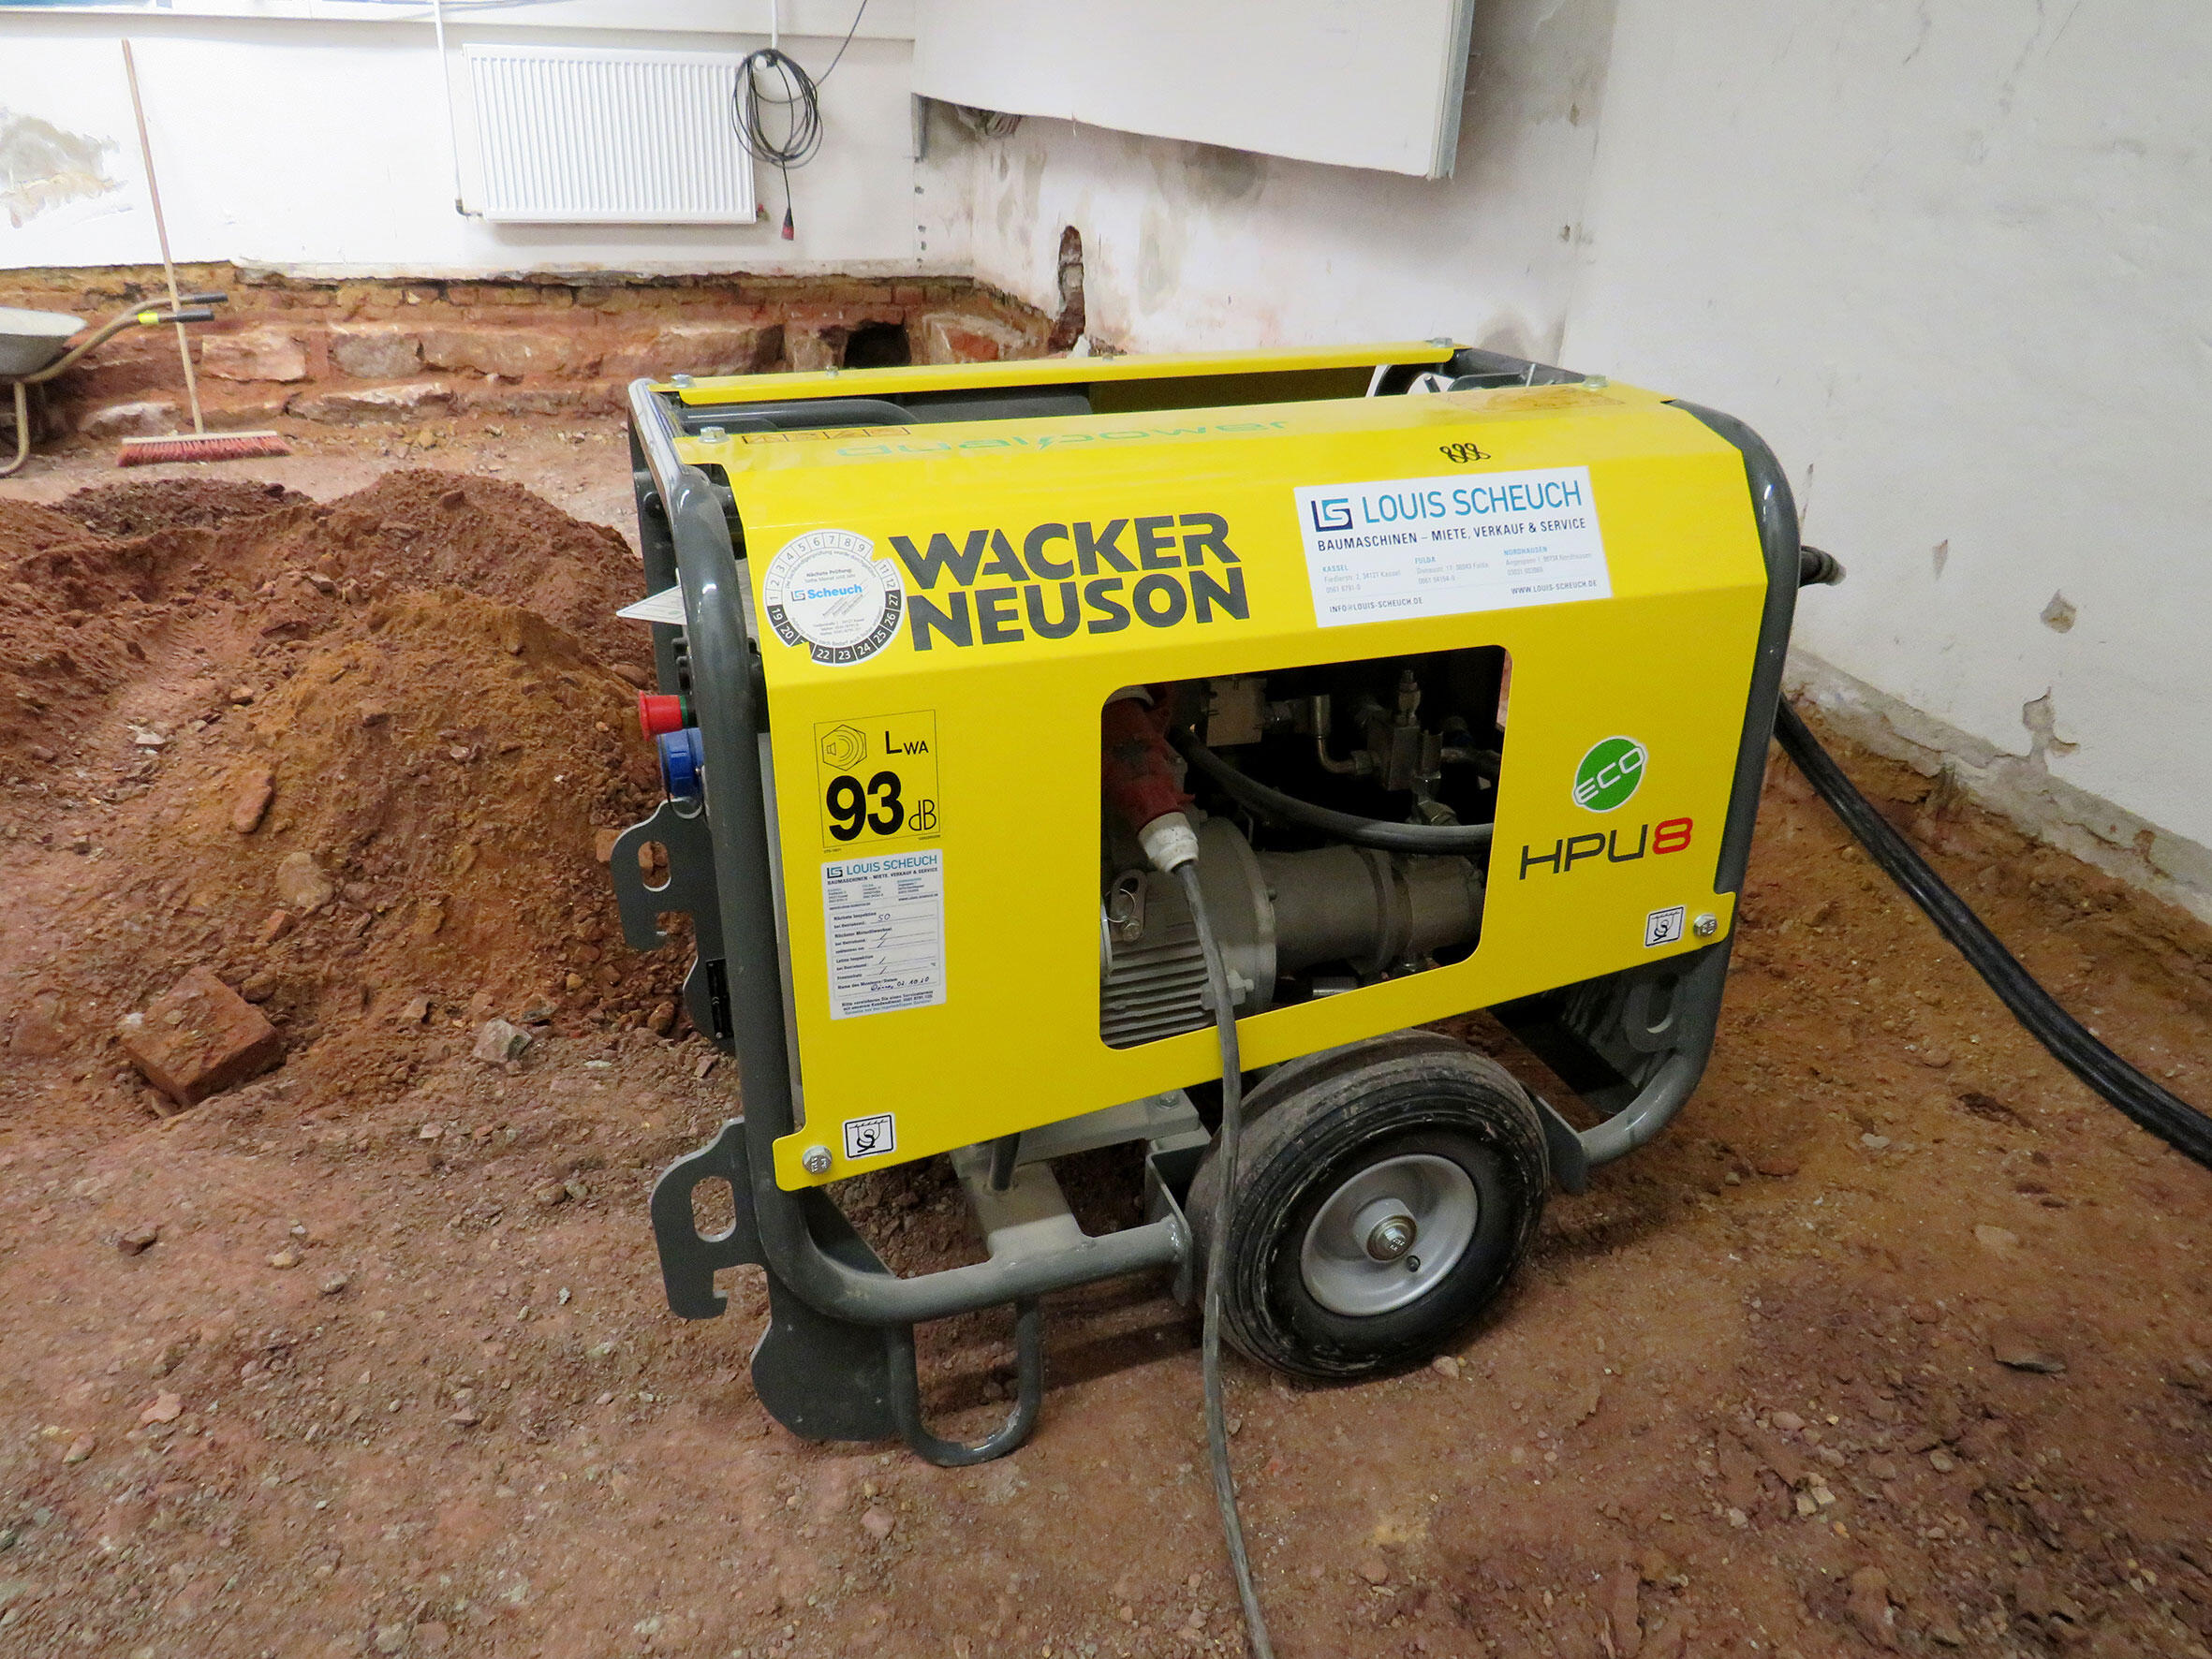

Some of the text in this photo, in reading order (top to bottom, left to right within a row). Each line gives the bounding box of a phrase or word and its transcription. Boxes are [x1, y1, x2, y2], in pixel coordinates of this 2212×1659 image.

[1362, 491, 1446, 523] LOUIS
[1453, 480, 1583, 516] SCHEUCH
[1318, 533, 1418, 551] BAUMASCHINEN
[1432, 528, 1471, 542] MIETE,
[1474, 522, 1525, 537] VERKAUF
[1528, 521, 1537, 533] &
[1540, 518, 1586, 532] SERVICE
[888, 512, 1242, 590] WACKER
[1415, 556, 1436, 565] FULDA
[1322, 565, 1349, 573] KASSEL
[807, 584, 863, 599] Scheuch
[889, 595, 898, 606] 27
[771, 609, 783, 621] 19
[907, 567, 1250, 652] NEUSON
[885, 613, 896, 627] 26
[780, 626, 794, 639] 20
[874, 631, 887, 643] 25
[817, 650, 830, 660] 22
[838, 650, 851, 660] 23
[858, 643, 871, 655] 24
[1574, 746, 1645, 804] ECO
[826, 771, 936, 842] 93 dB
[1519, 817, 1693, 880] HPU8
[847, 862, 880, 875] LOUIS
[884, 855, 937, 871] SCHEUCH
